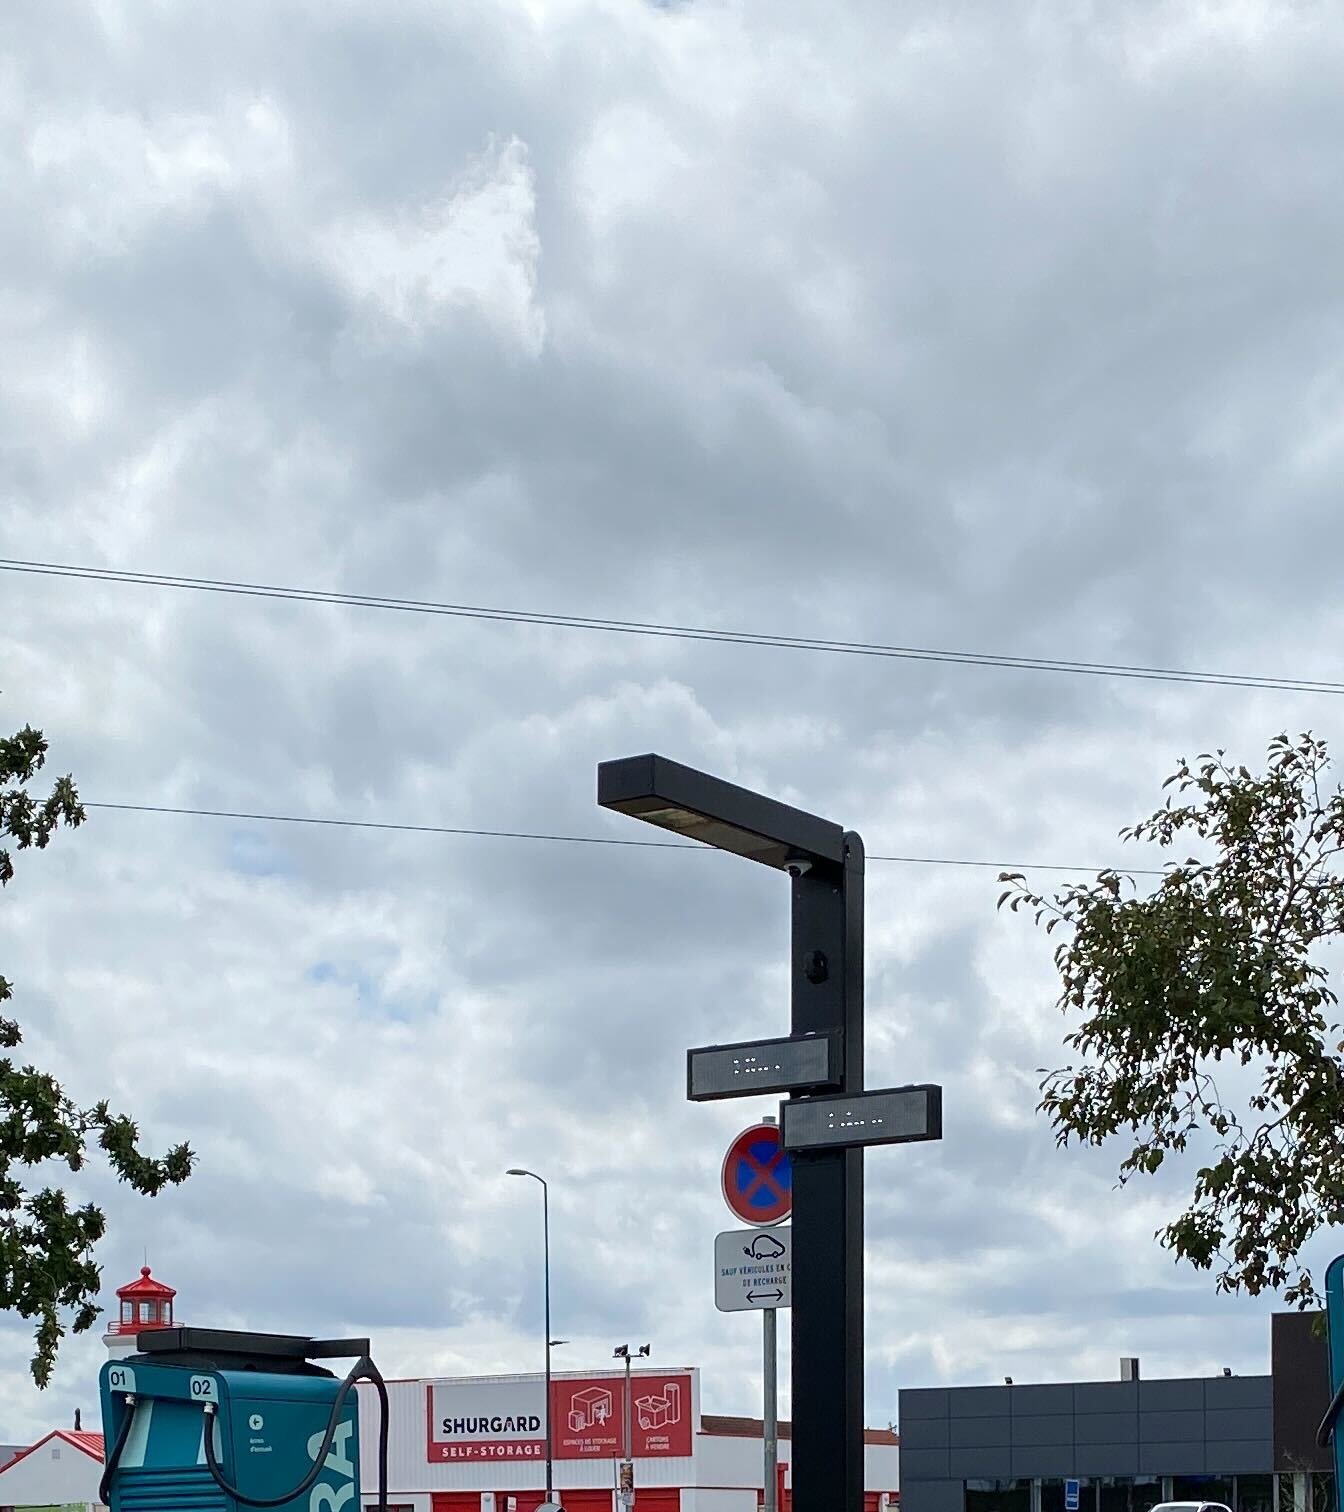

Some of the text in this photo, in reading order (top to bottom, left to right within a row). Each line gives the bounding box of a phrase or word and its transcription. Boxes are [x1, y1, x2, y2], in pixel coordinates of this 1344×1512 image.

[721, 1267, 737, 1276] SAUF
[776, 1263, 785, 1272] EN
[742, 1275, 787, 1287] DE RECHARGE
[110, 1370, 127, 1386] 01
[192, 1380, 211, 1395] 02
[442, 1415, 541, 1434] SHURGARD
[442, 1445, 541, 1458] SELF-STORAGE
